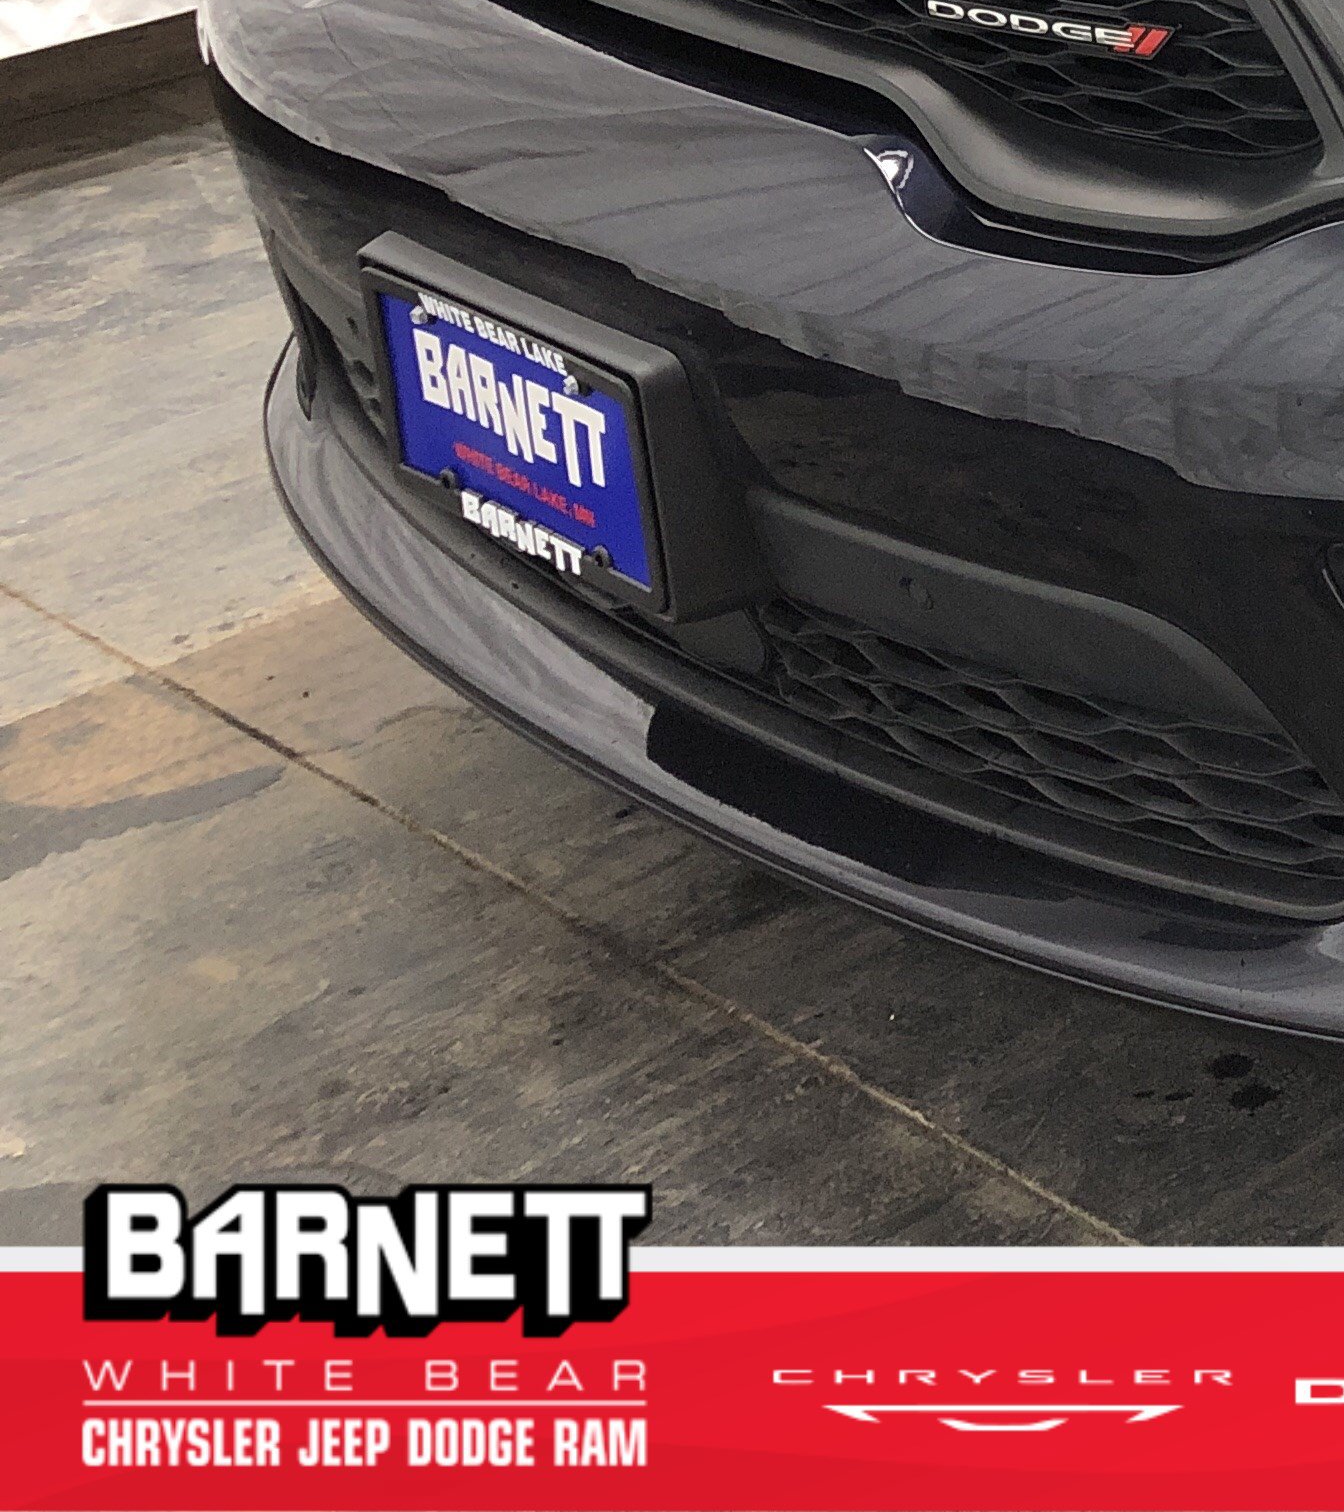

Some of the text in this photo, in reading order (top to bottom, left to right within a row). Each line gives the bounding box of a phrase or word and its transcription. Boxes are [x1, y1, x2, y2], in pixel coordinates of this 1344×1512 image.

[927, 0, 1135, 48] DODGE
[417, 292, 568, 376] WHITE BEAR LAKE
[412, 328, 606, 488] BARNETT
[461, 489, 586, 577] BARNETT
